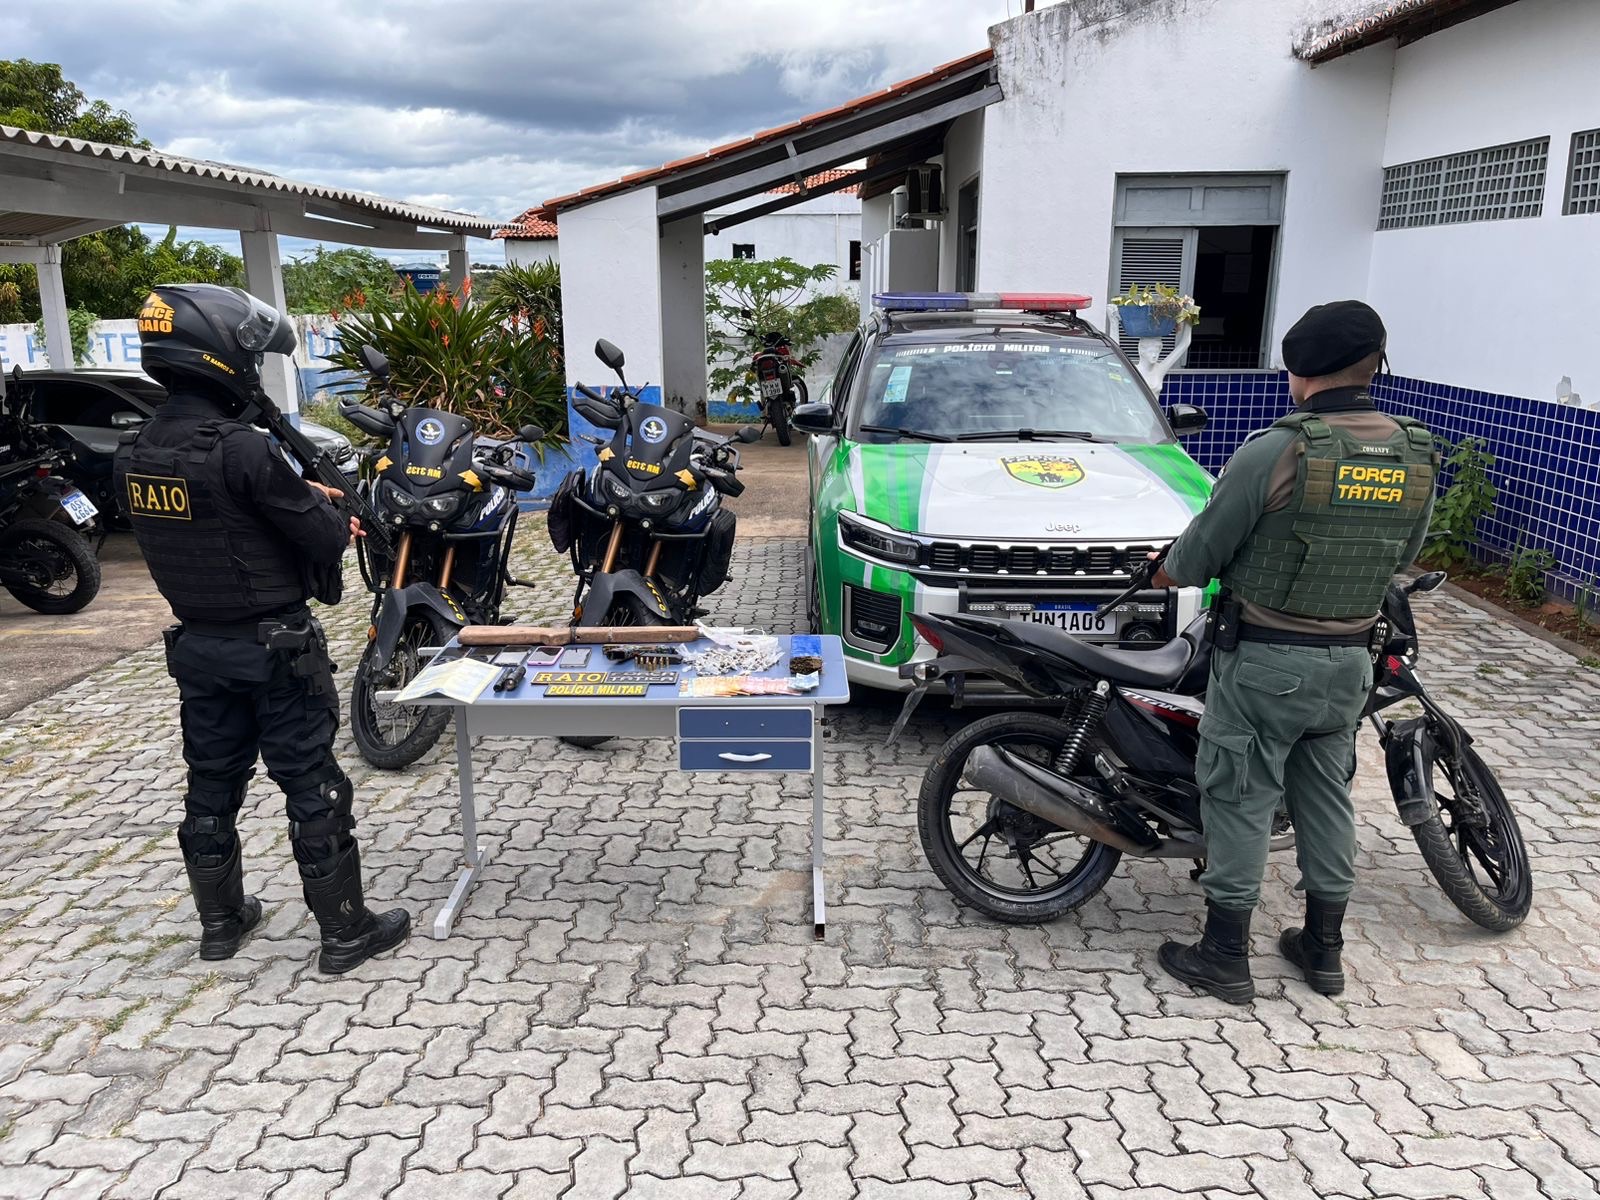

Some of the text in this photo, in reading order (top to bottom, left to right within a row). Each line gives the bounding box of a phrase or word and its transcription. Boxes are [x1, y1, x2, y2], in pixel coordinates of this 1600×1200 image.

[138, 319, 172, 333] RAIO
[943, 343, 1050, 353] POLÍCIA MILITAR
[1339, 466, 1406, 484] FORÇA
[129, 481, 187, 513] RAIO
[1338, 483, 1403, 502] TÁTICA
[1045, 521, 1082, 534] Jeep
[536, 673, 602, 682] RAIO
[548, 684, 644, 696] POLÍCIA MILITAR
